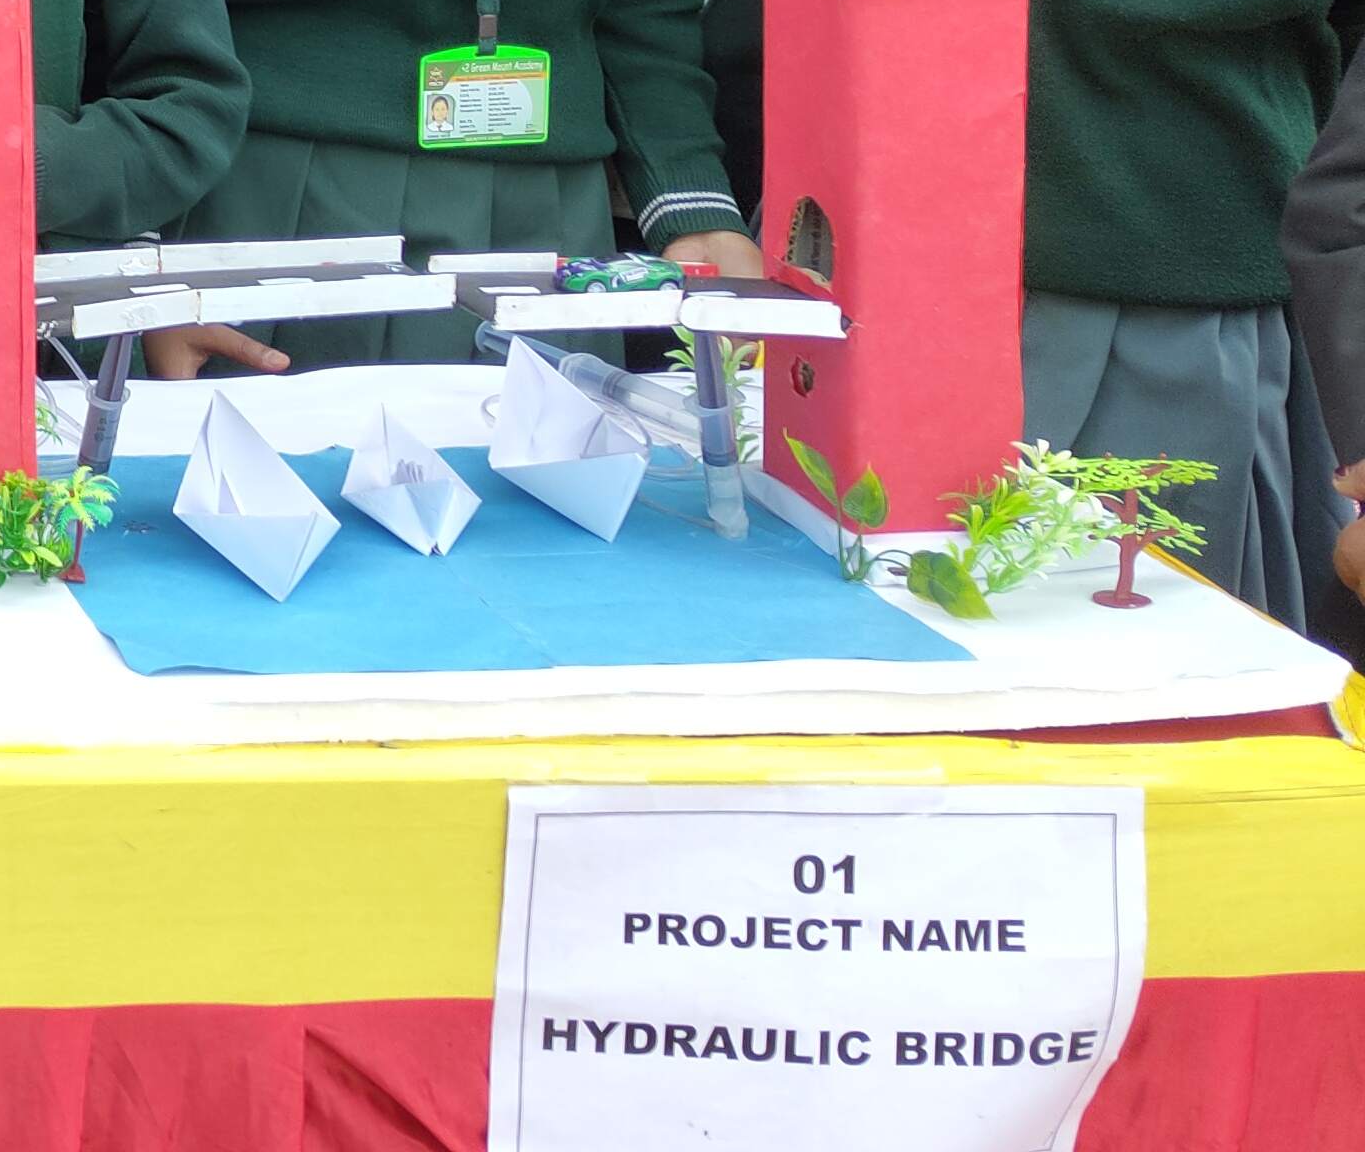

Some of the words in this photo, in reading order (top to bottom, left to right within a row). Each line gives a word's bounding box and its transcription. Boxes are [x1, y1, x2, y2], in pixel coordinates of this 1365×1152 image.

[792, 854, 857, 896] 01
[623, 912, 863, 952] PROJECT
[881, 918, 1027, 953] NAME
[541, 1017, 872, 1067] HYDRAULIC
[895, 1028, 1099, 1067] BRIDGE
